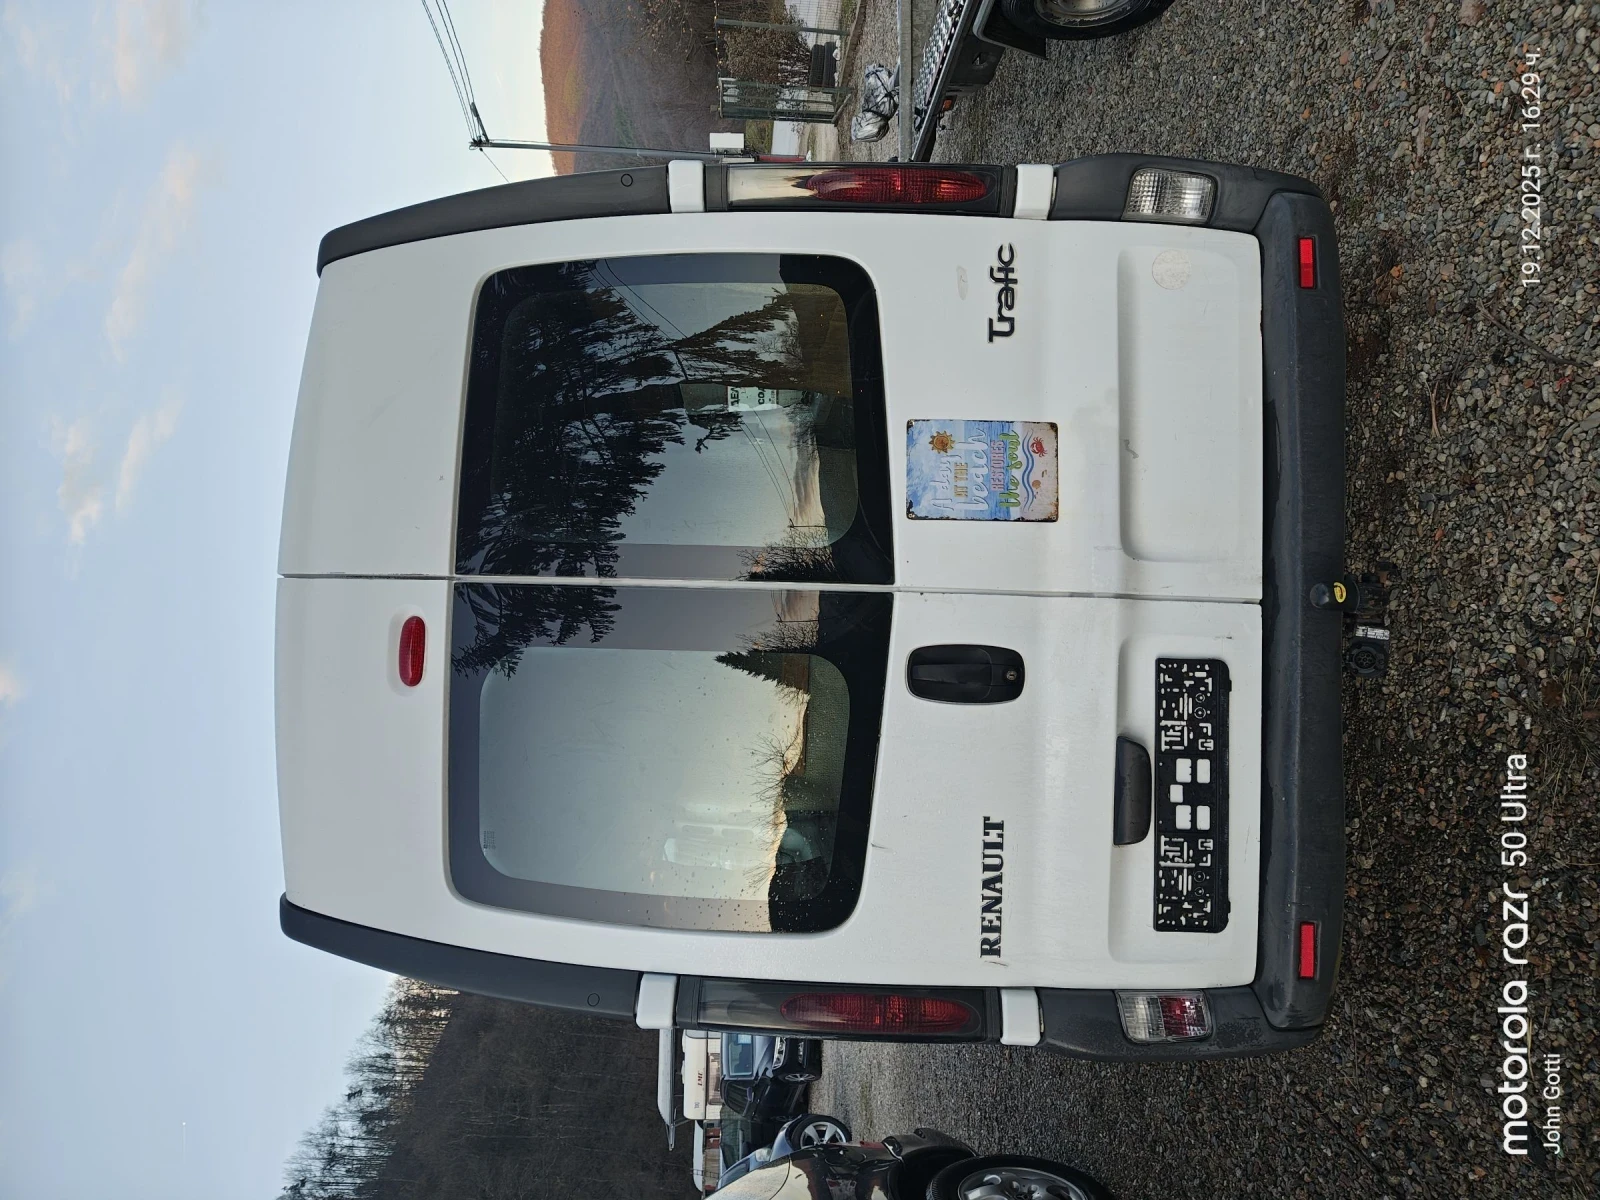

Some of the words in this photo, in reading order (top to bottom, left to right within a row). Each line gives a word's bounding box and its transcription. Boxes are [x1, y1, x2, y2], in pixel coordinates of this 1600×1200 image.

[987, 242, 1018, 343] Trafic
[954, 427, 989, 511] beach
[990, 440, 1005, 491] RESTORES
[1000, 430, 1023, 470] soul
[928, 454, 962, 490] day
[954, 462, 968, 482] THE
[930, 497, 954, 512] A
[954, 485, 968, 498] AT
[999, 475, 1021, 508] the
[979, 816, 1004, 958] RENAULT
